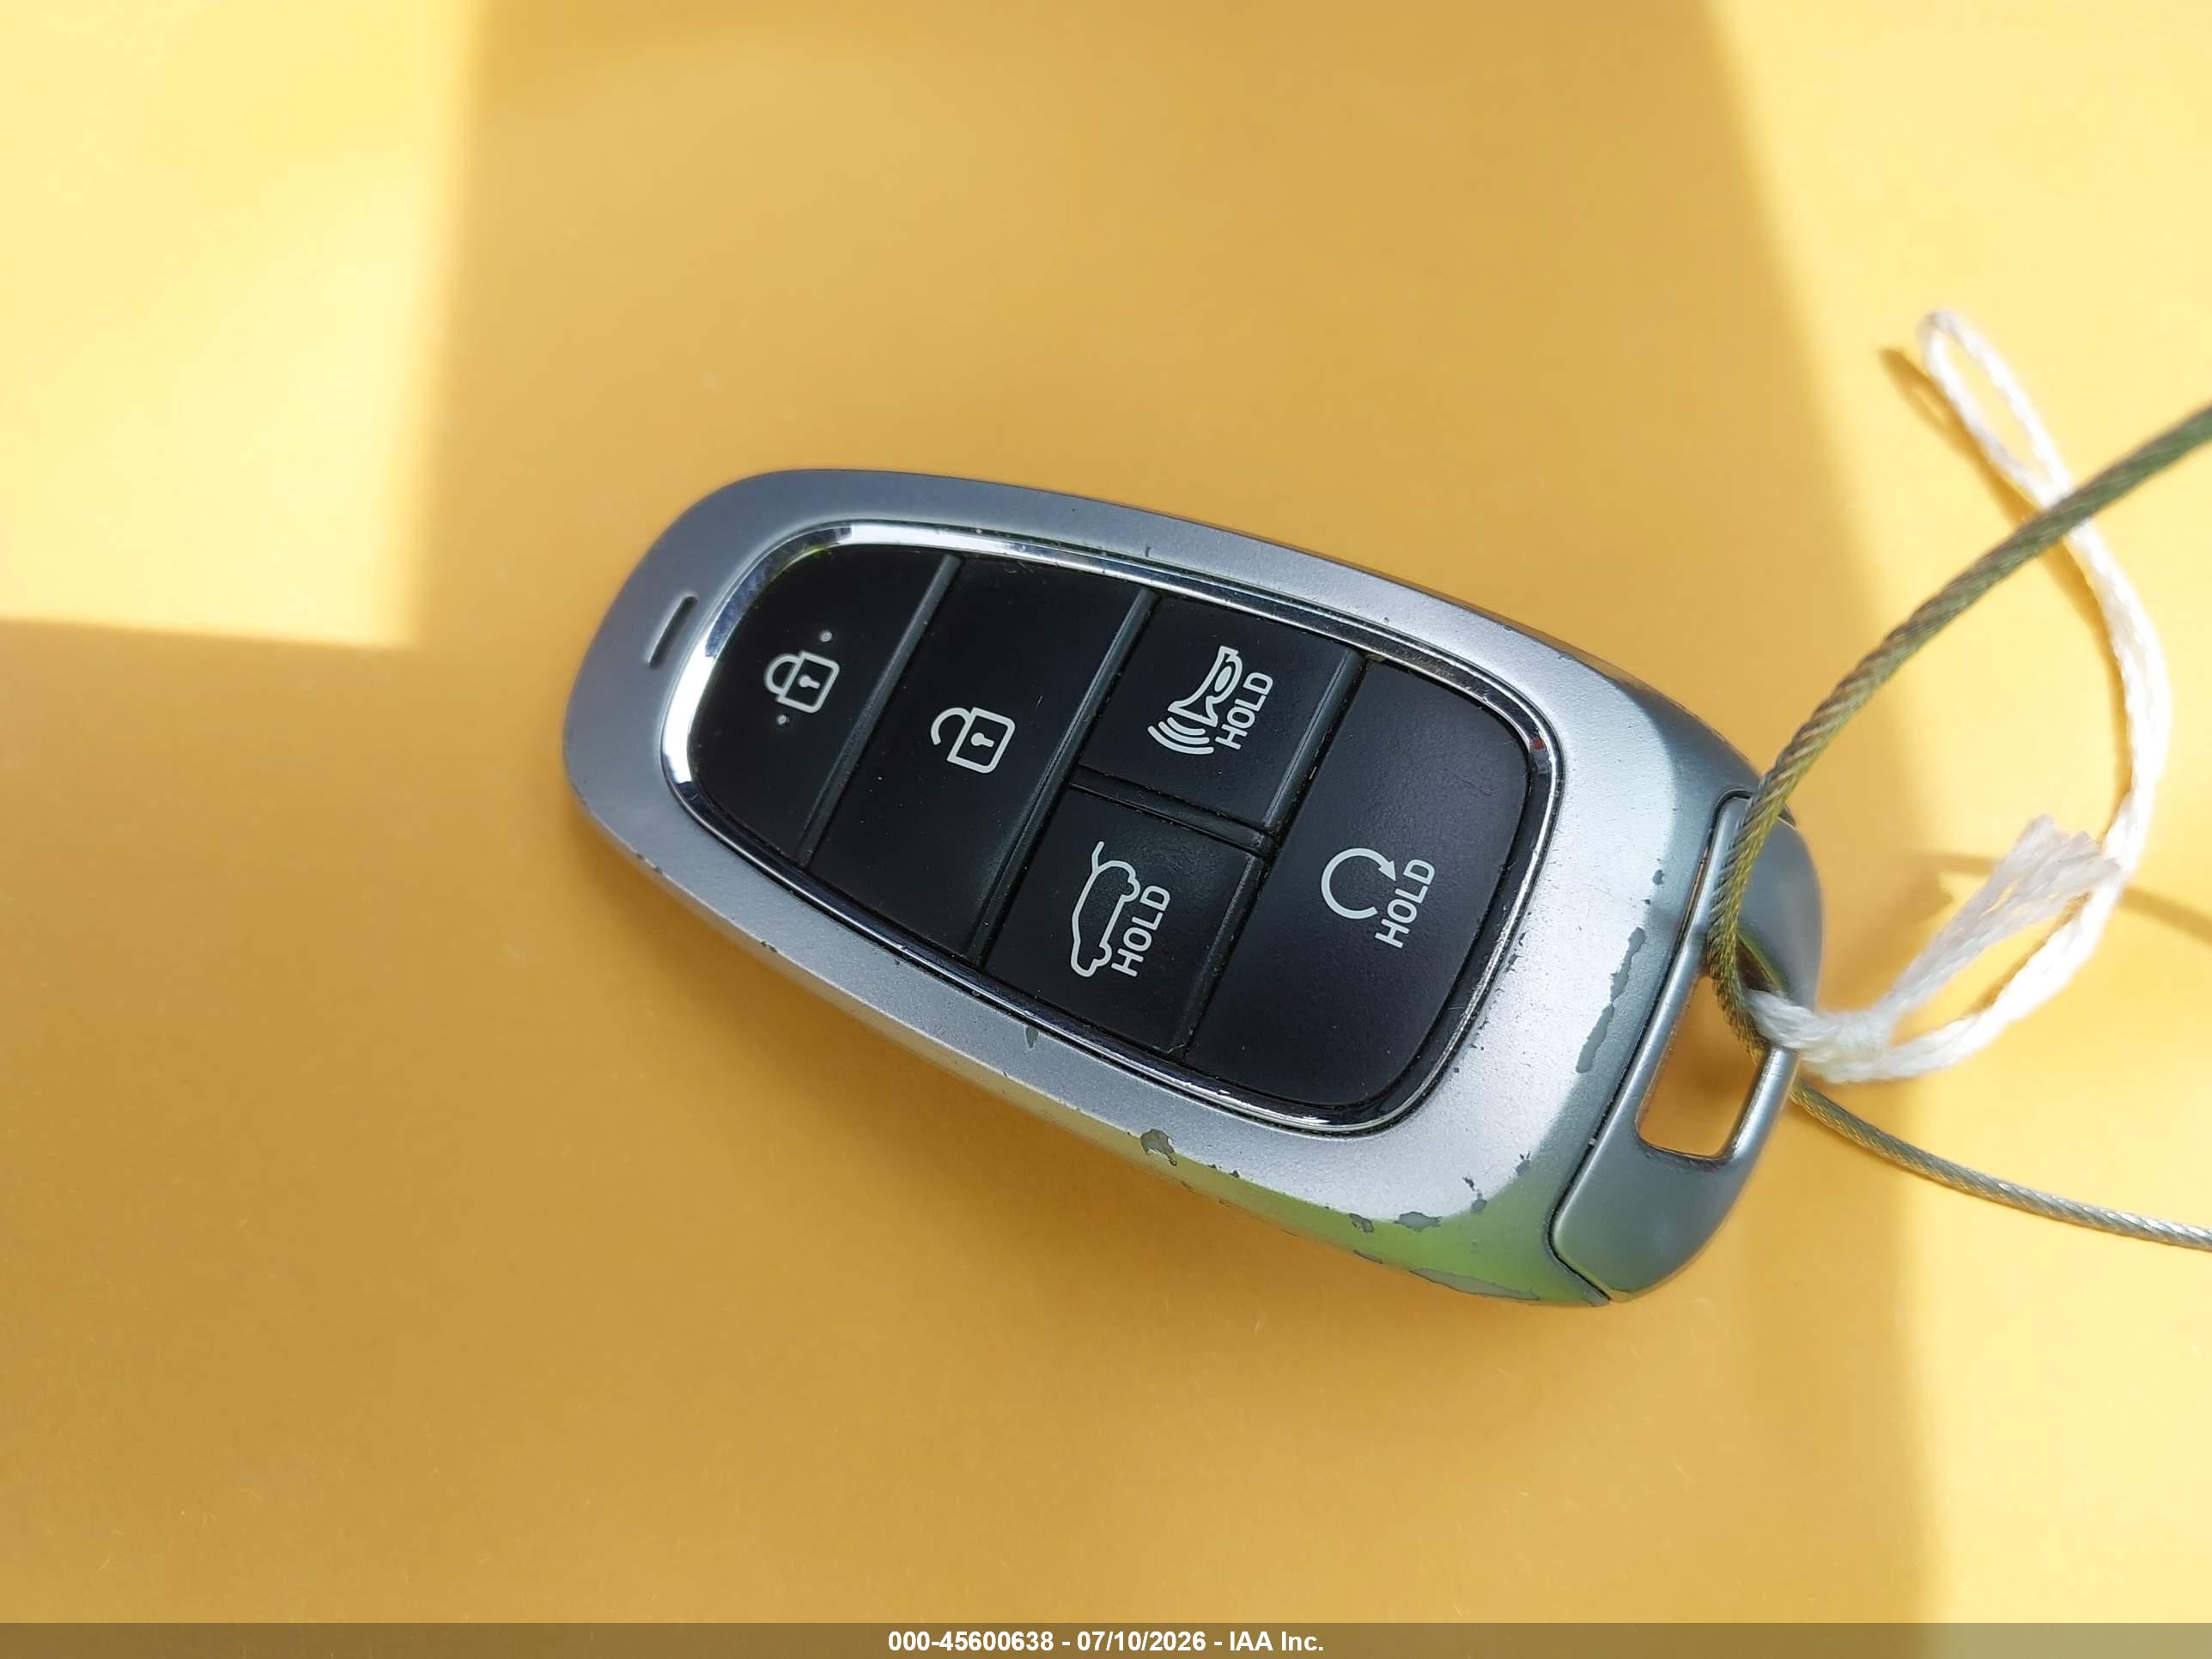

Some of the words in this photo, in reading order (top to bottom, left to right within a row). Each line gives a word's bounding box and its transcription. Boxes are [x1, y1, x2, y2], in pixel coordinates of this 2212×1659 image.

[1214, 672, 1273, 750] HOLD
[1110, 884, 1170, 977] HOLD
[1374, 859, 1436, 949] HOLD
